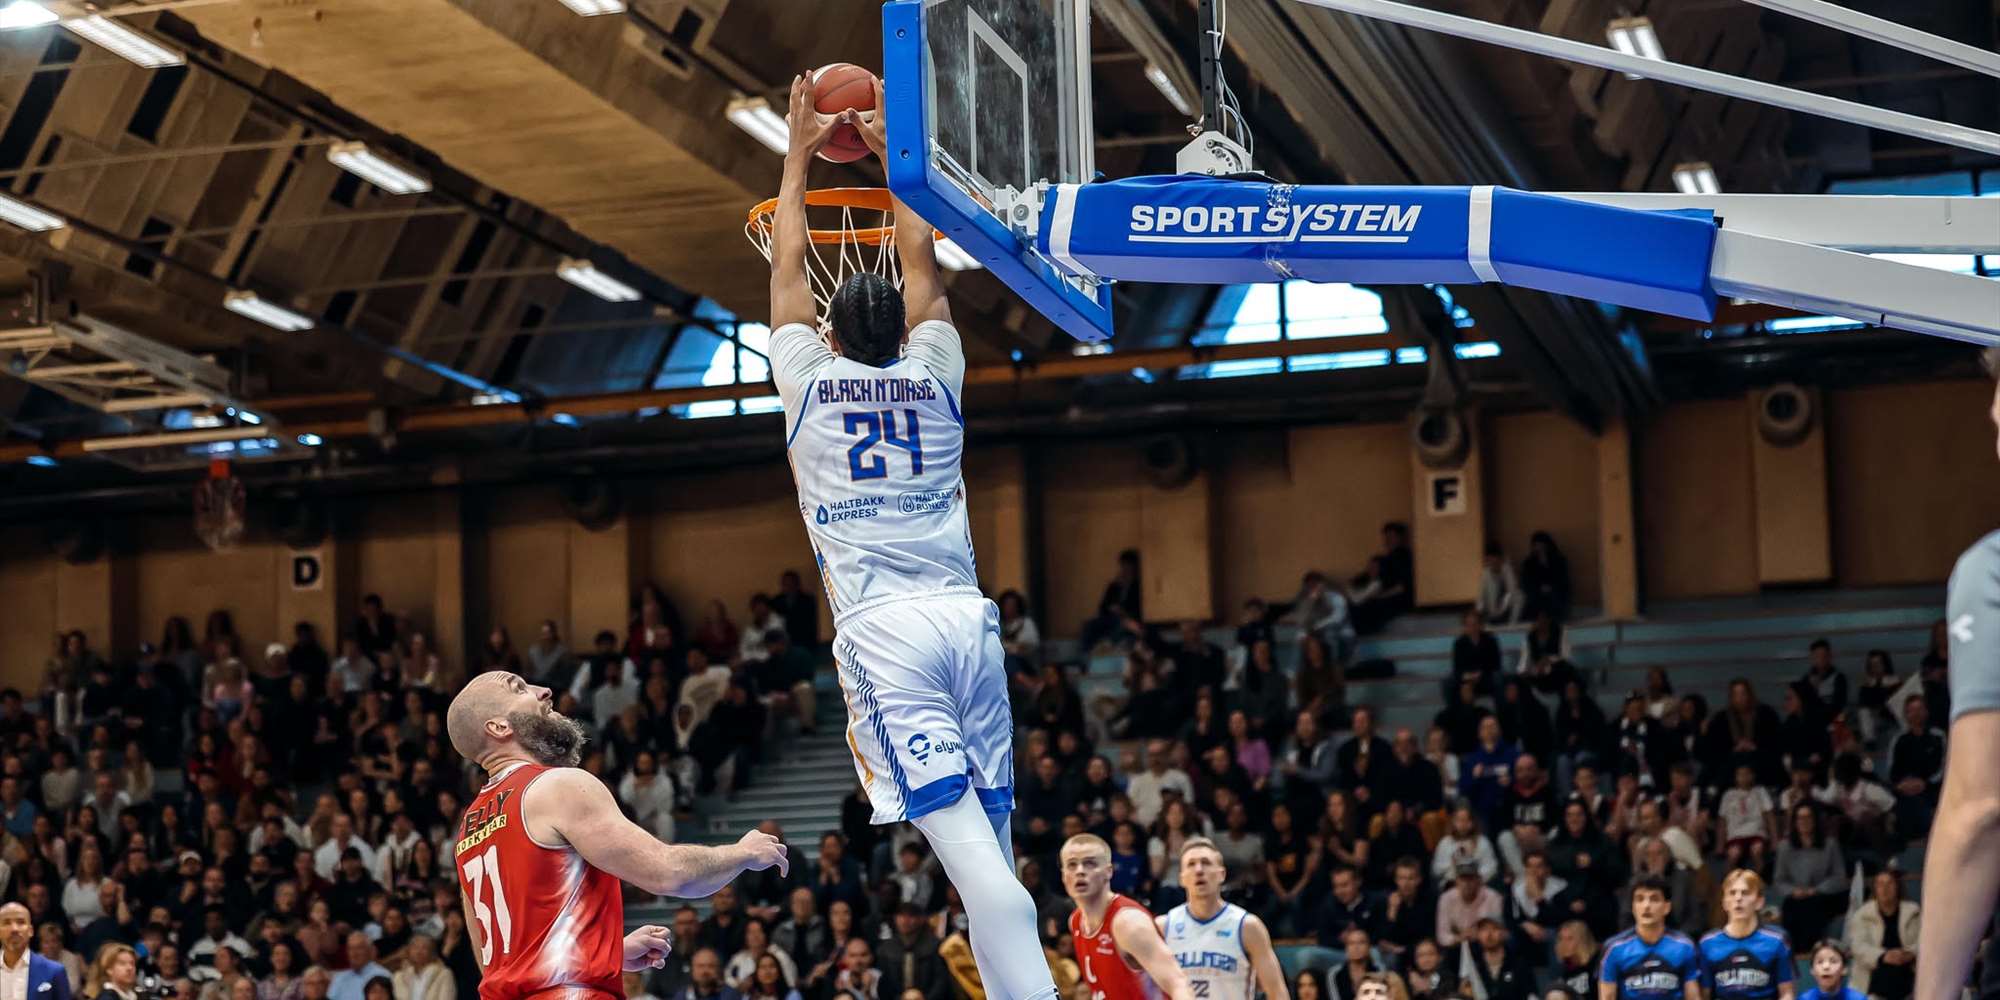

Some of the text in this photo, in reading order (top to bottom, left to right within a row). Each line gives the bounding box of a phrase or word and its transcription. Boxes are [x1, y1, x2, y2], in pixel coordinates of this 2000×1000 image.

[1130, 203, 1422, 242] SPORT SYSTEM
[818, 379, 872, 404] BLACK
[842, 408, 924, 482] 24
[830, 495, 886, 511] HALTBAKK
[1434, 477, 1458, 510] F
[831, 507, 879, 522] EXPRESS
[293, 555, 320, 588] D
[462, 844, 512, 966] 31
